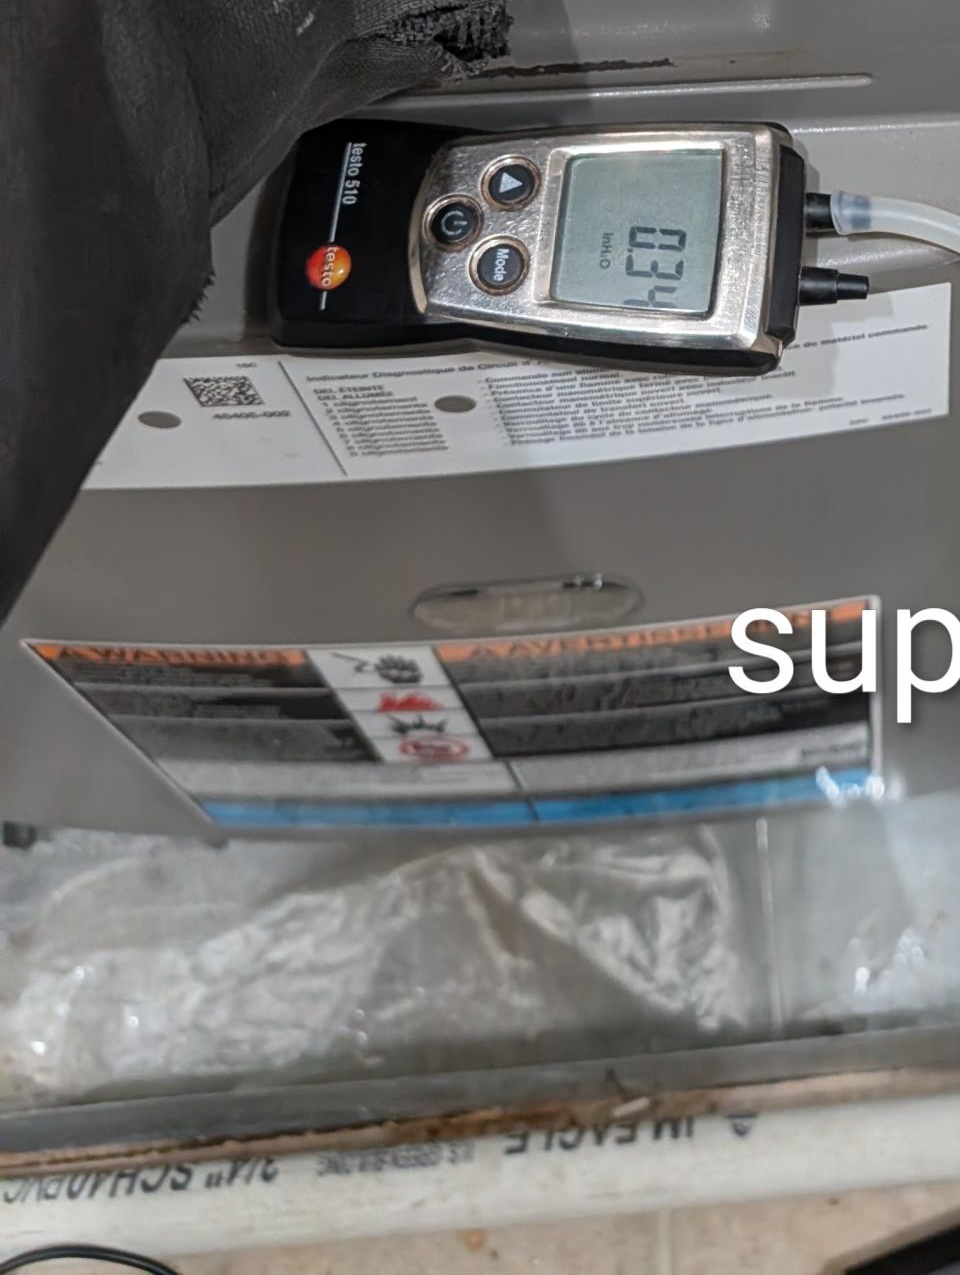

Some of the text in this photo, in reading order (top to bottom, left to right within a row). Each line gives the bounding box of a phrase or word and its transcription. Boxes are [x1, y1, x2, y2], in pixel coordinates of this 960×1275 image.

[342, 141, 366, 206] testo 510
[319, 245, 339, 289] testo
[493, 248, 507, 282] Mode
